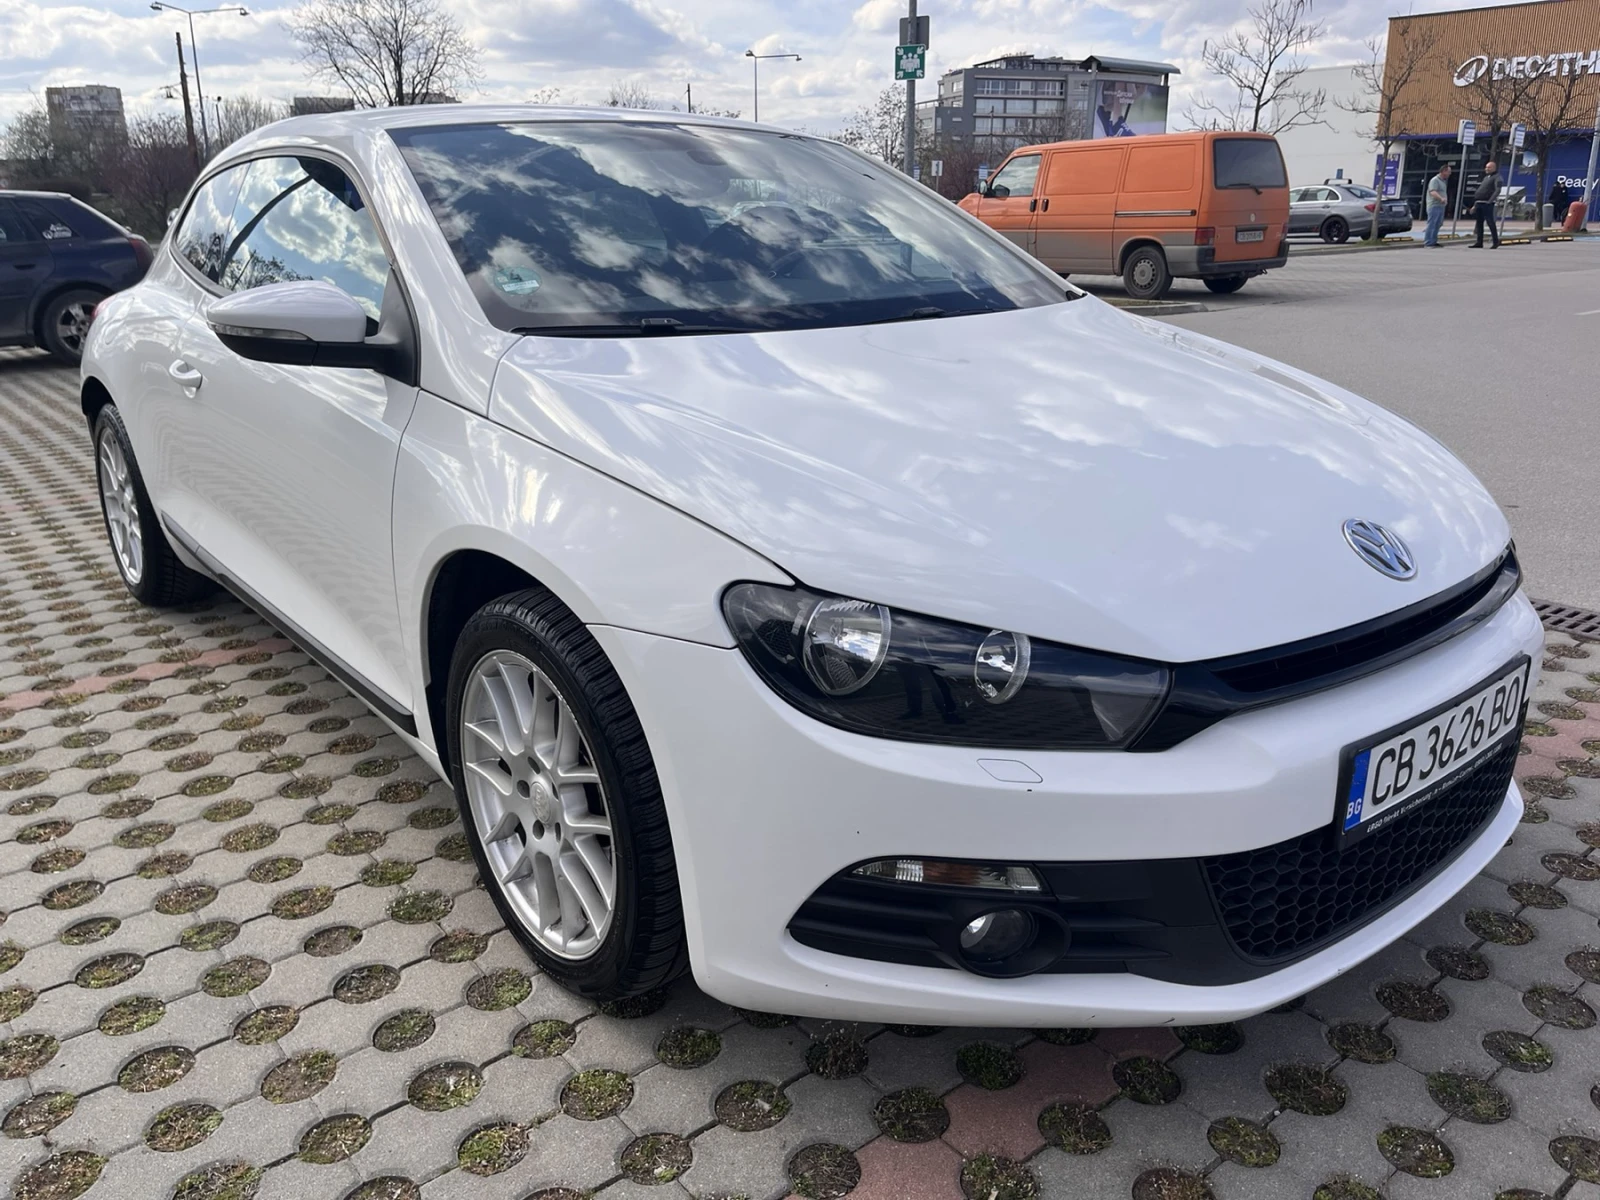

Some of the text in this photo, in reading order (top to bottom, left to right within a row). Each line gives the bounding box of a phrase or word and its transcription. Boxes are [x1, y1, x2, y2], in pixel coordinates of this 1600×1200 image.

[1371, 737, 1416, 806] CB
[1418, 695, 1488, 780] 3626
[1487, 675, 1520, 740] BO
[1346, 797, 1362, 820] BG
